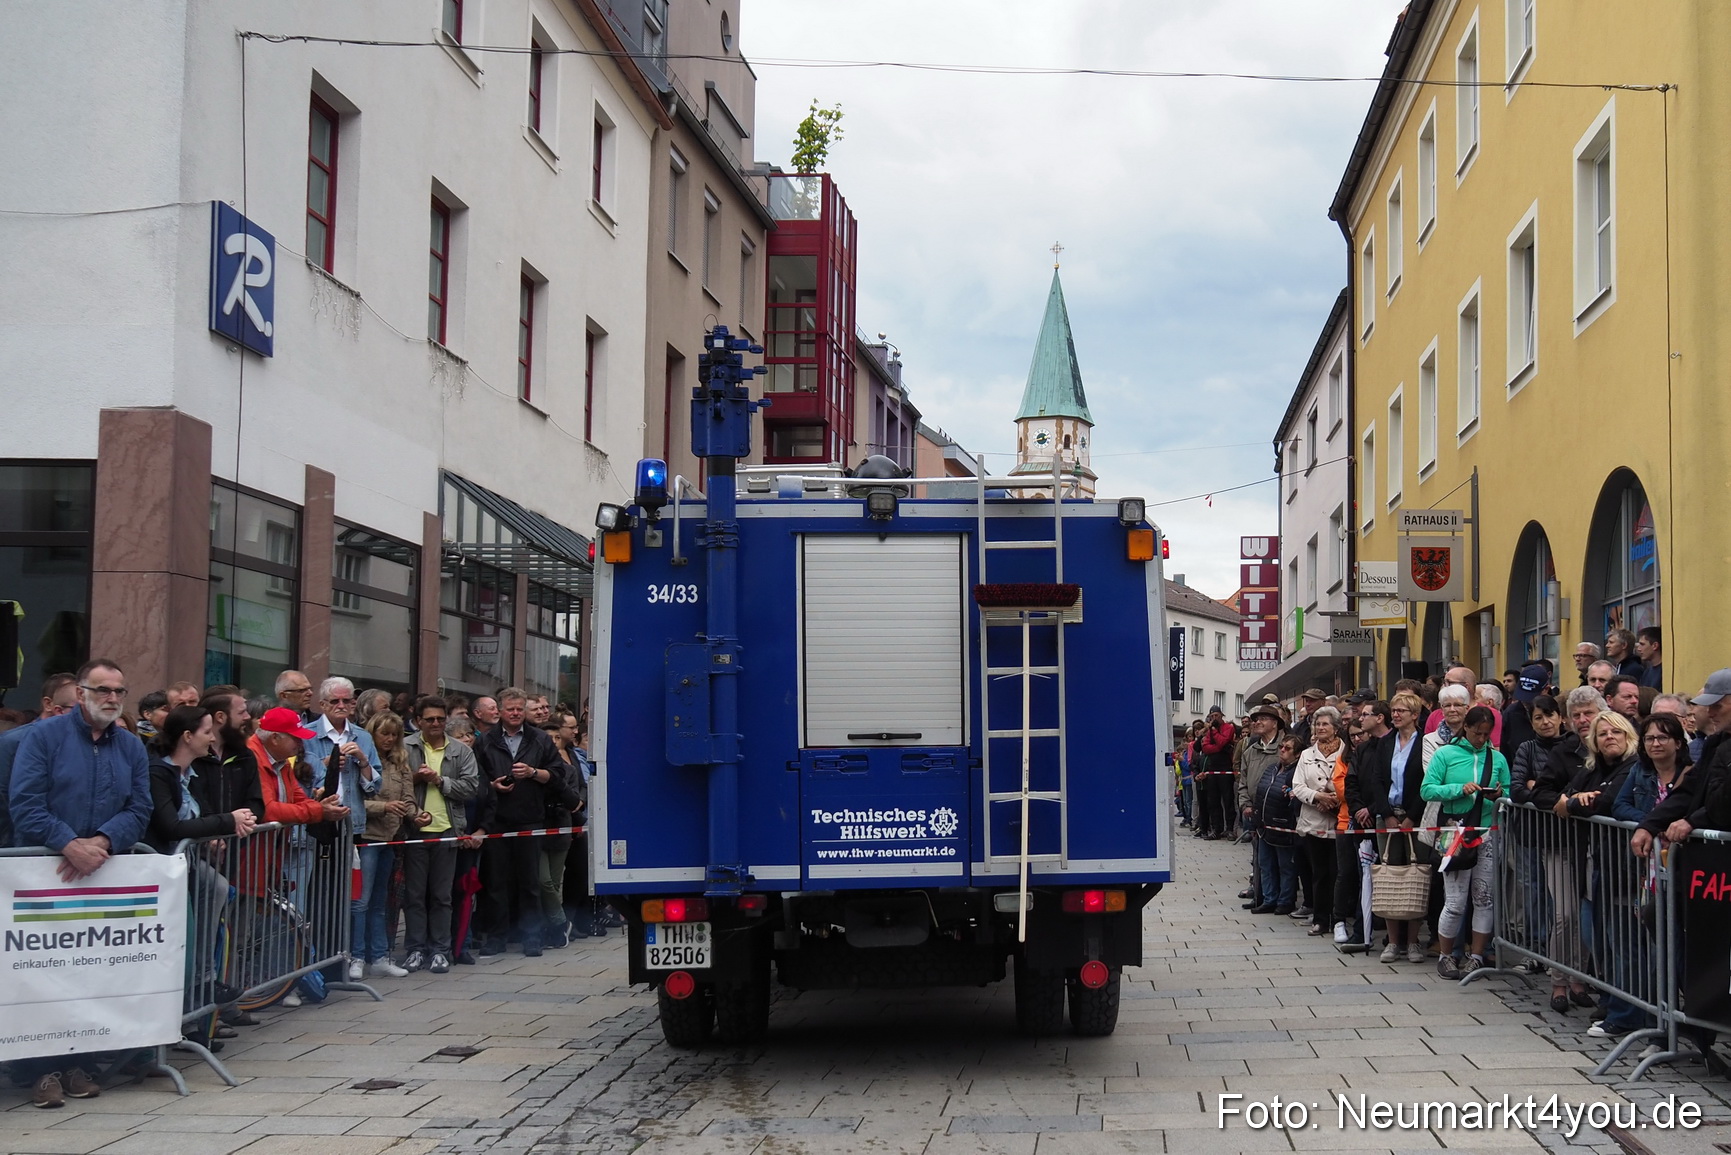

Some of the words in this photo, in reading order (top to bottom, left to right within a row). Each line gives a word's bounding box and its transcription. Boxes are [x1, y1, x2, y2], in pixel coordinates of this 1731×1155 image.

[1404, 515, 1449, 525] RATHAUS
[1451, 515, 1457, 525] II
[1361, 572, 1397, 584] Dessous
[647, 584, 698, 603] 34/33
[1333, 629, 1362, 638] SARAH
[1364, 629, 1371, 638] K
[1241, 648, 1276, 659] WITT
[1241, 661, 1277, 669] WEIDEN
[811, 808, 926, 824] Technisches
[840, 824, 927, 840] Hilfswerk
[817, 846, 956, 858] www.thw-neumarkt.de
[5, 923, 165, 952] NeuerMarkt
[12, 959, 66, 970] einkaufen
[72, 957, 102, 966] leben
[108, 952, 157, 966] genießen
[651, 946, 705, 966] 82506
